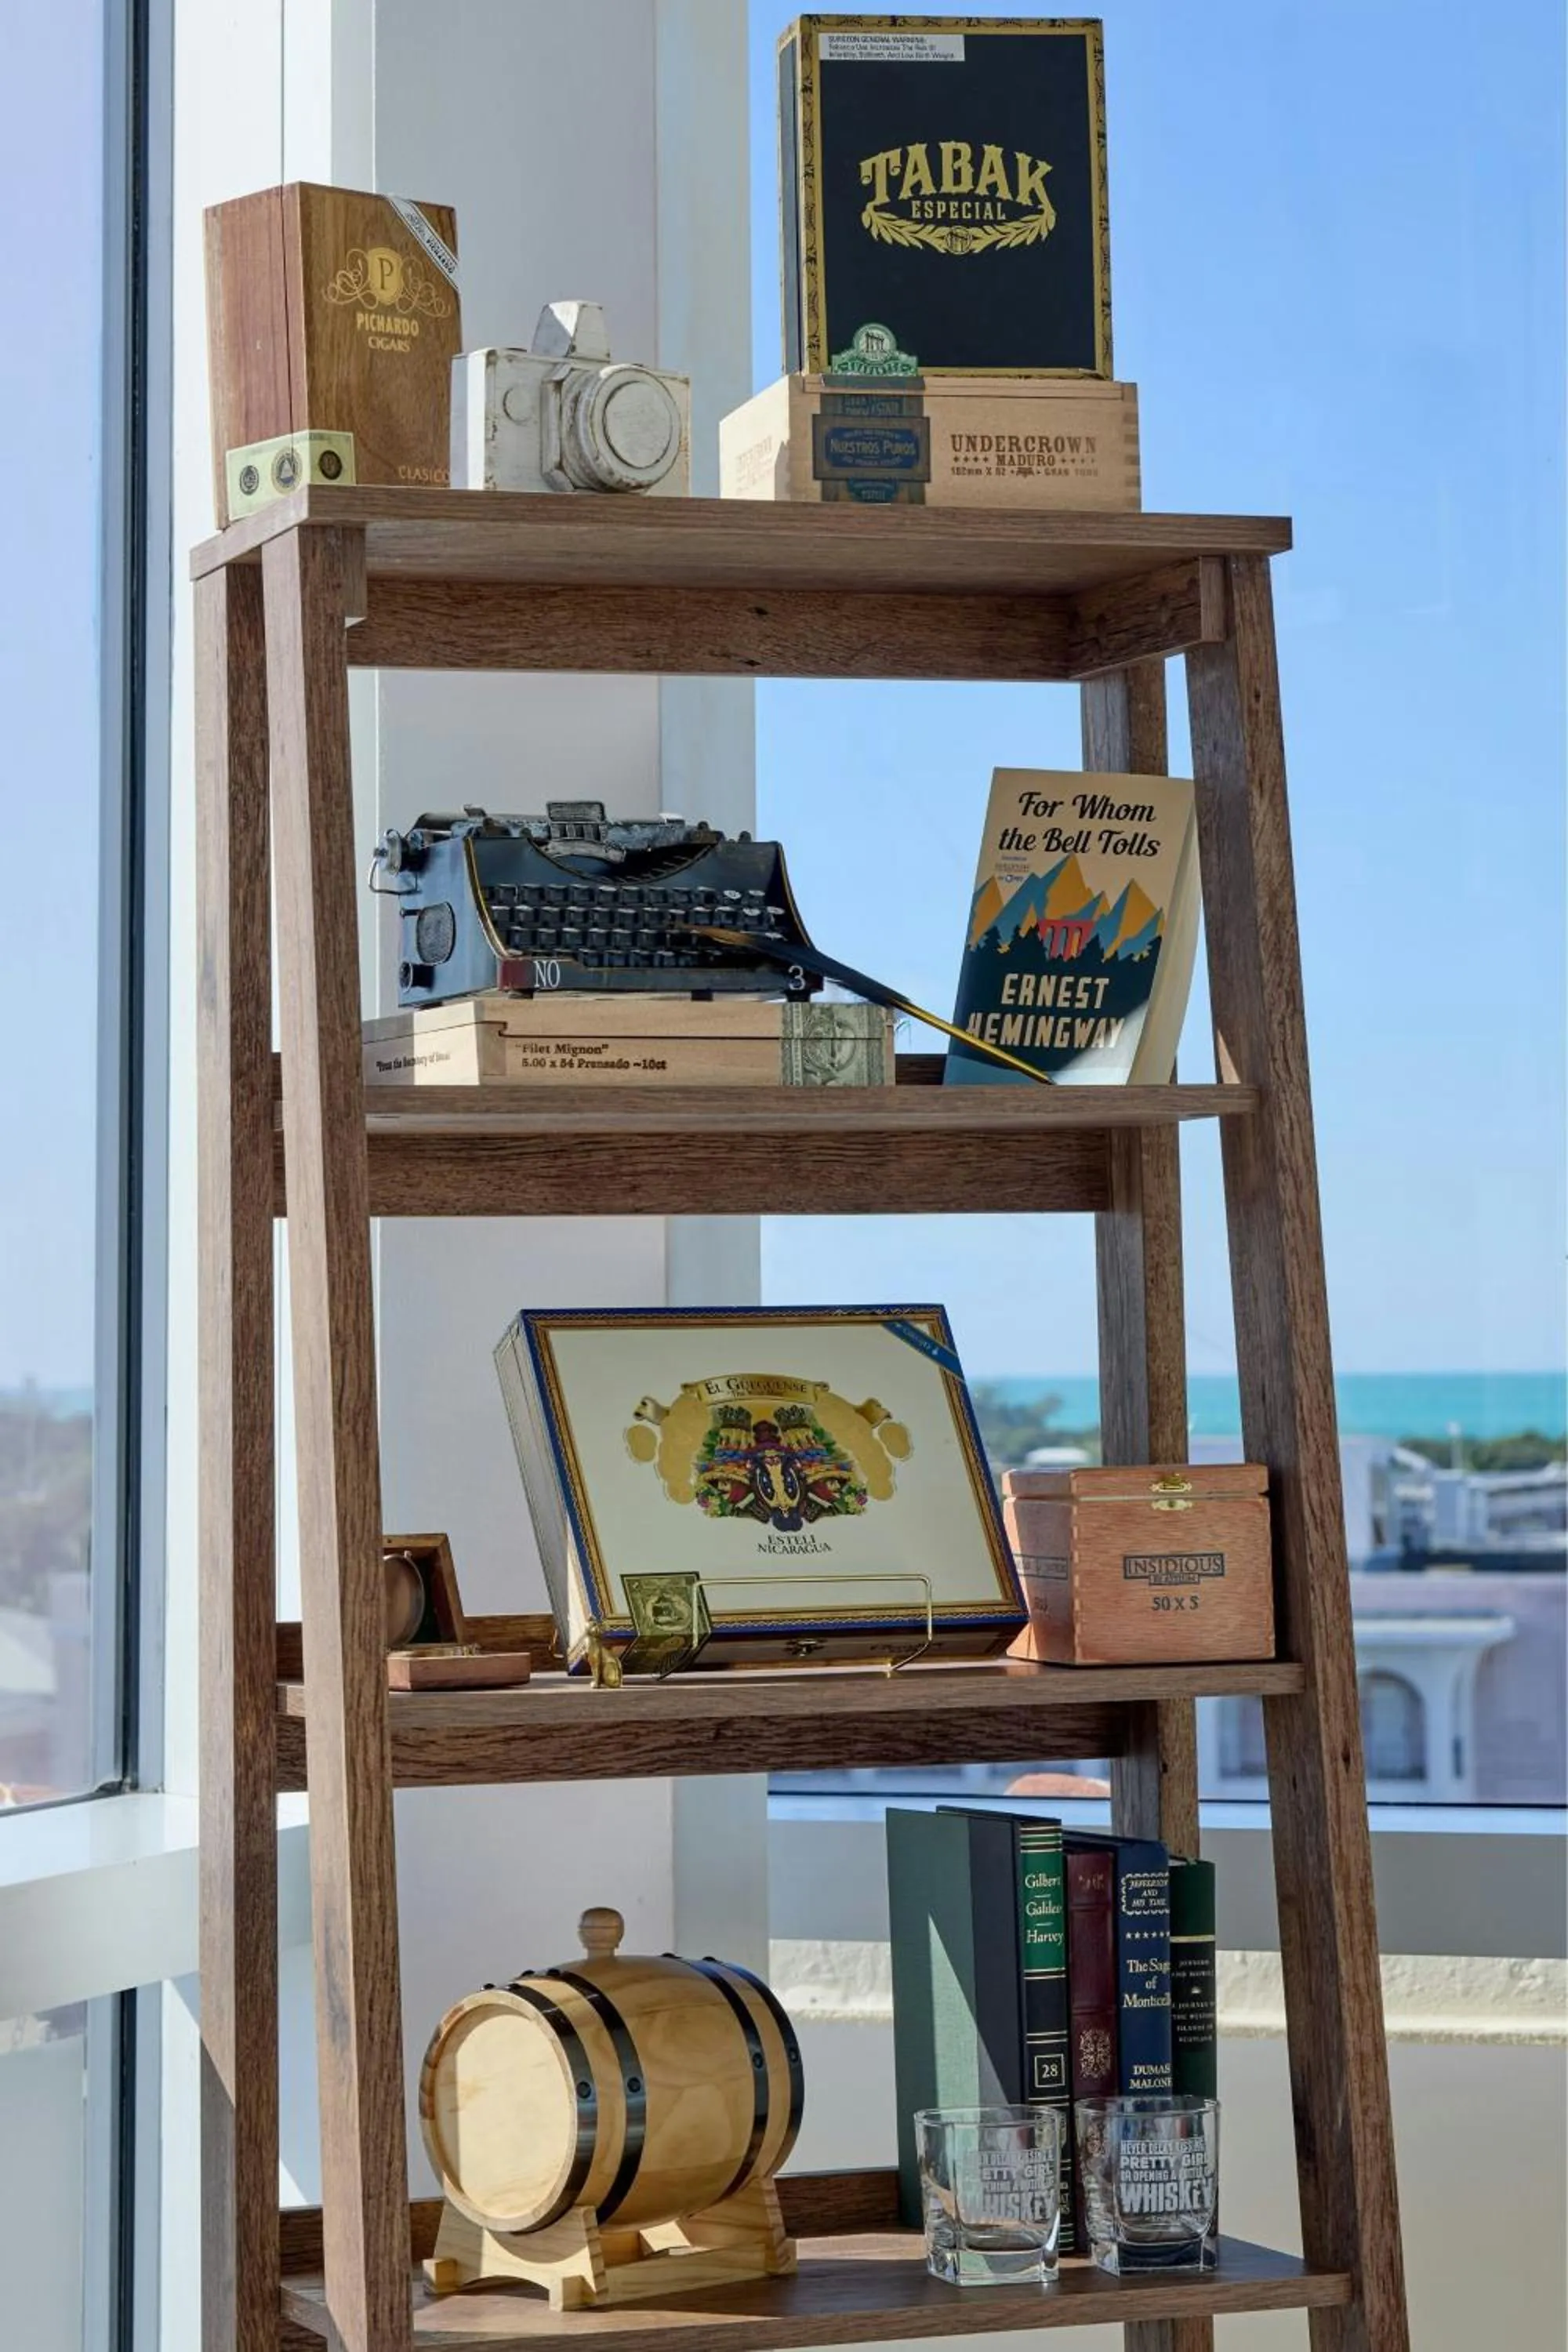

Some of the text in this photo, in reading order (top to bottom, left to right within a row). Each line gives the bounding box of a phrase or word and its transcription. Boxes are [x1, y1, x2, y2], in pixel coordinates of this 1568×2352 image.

[859, 140, 1053, 205] TABAK
[911, 199, 1007, 220] ESPECIAL
[379, 257, 394, 290] P
[357, 312, 419, 337] PICHARDO
[368, 336, 411, 353] CIGARS
[950, 434, 1097, 454] UNDERCROWN
[996, 454, 1056, 466] MADURO
[1018, 791, 1157, 822] For Whom
[998, 826, 1161, 858] the Bell Tolls
[788, 965, 806, 990] 3
[1000, 973, 1110, 1010] ERNEST
[965, 1011, 1126, 1049] HEMINGWAY
[757, 1542, 833, 1554] NICARAGUA
[1127, 1557, 1221, 1575] INSIDIOUS
[1152, 1595, 1171, 1611] 50
[1024, 1872, 1062, 1889] Gilbert
[1026, 1929, 1065, 1946] Harvey
[1127, 1959, 1149, 1973] The
[1145, 1976, 1158, 1990] of
[1042, 2063, 1058, 2078] 28
[1132, 2063, 1171, 2076] DUMAS
[1120, 2155, 1175, 2169] PRETTY
[972, 2164, 1054, 2180] ETTY GIRL
[1120, 2179, 1214, 2213] WHISKEY
